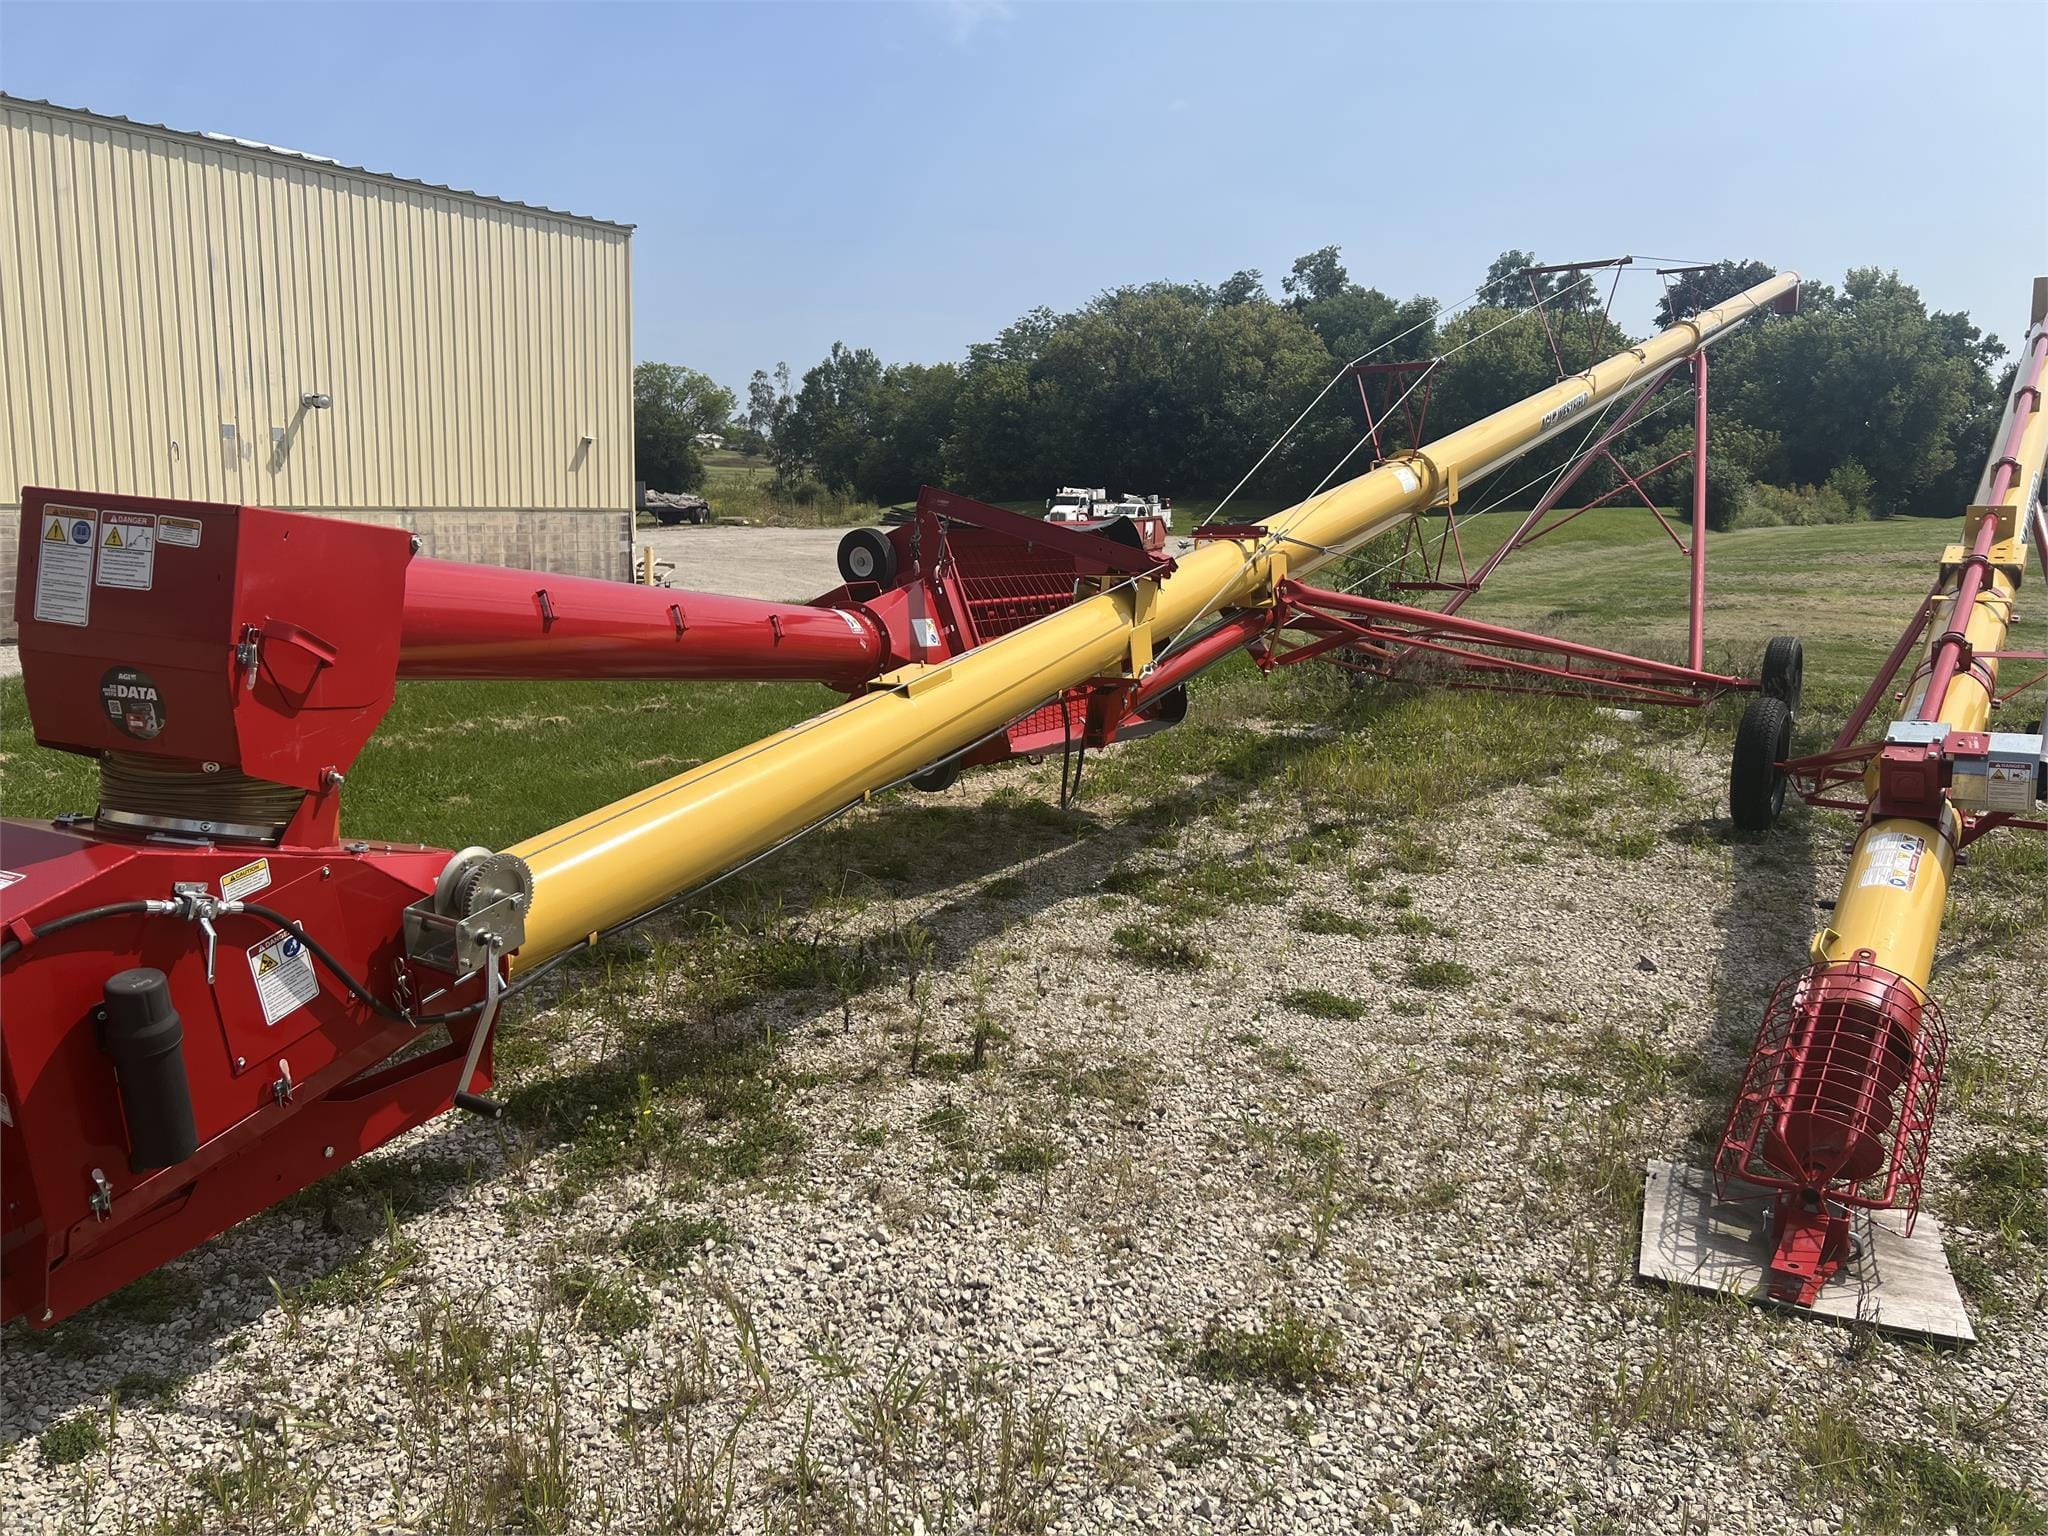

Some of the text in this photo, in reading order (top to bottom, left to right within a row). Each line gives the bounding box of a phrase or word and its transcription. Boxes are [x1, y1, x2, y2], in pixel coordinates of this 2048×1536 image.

[118, 515, 147, 525] DANGER
[117, 685, 158, 700] DATA
[235, 865, 260, 878] CAUTION
[265, 931, 290, 948] DANGE
